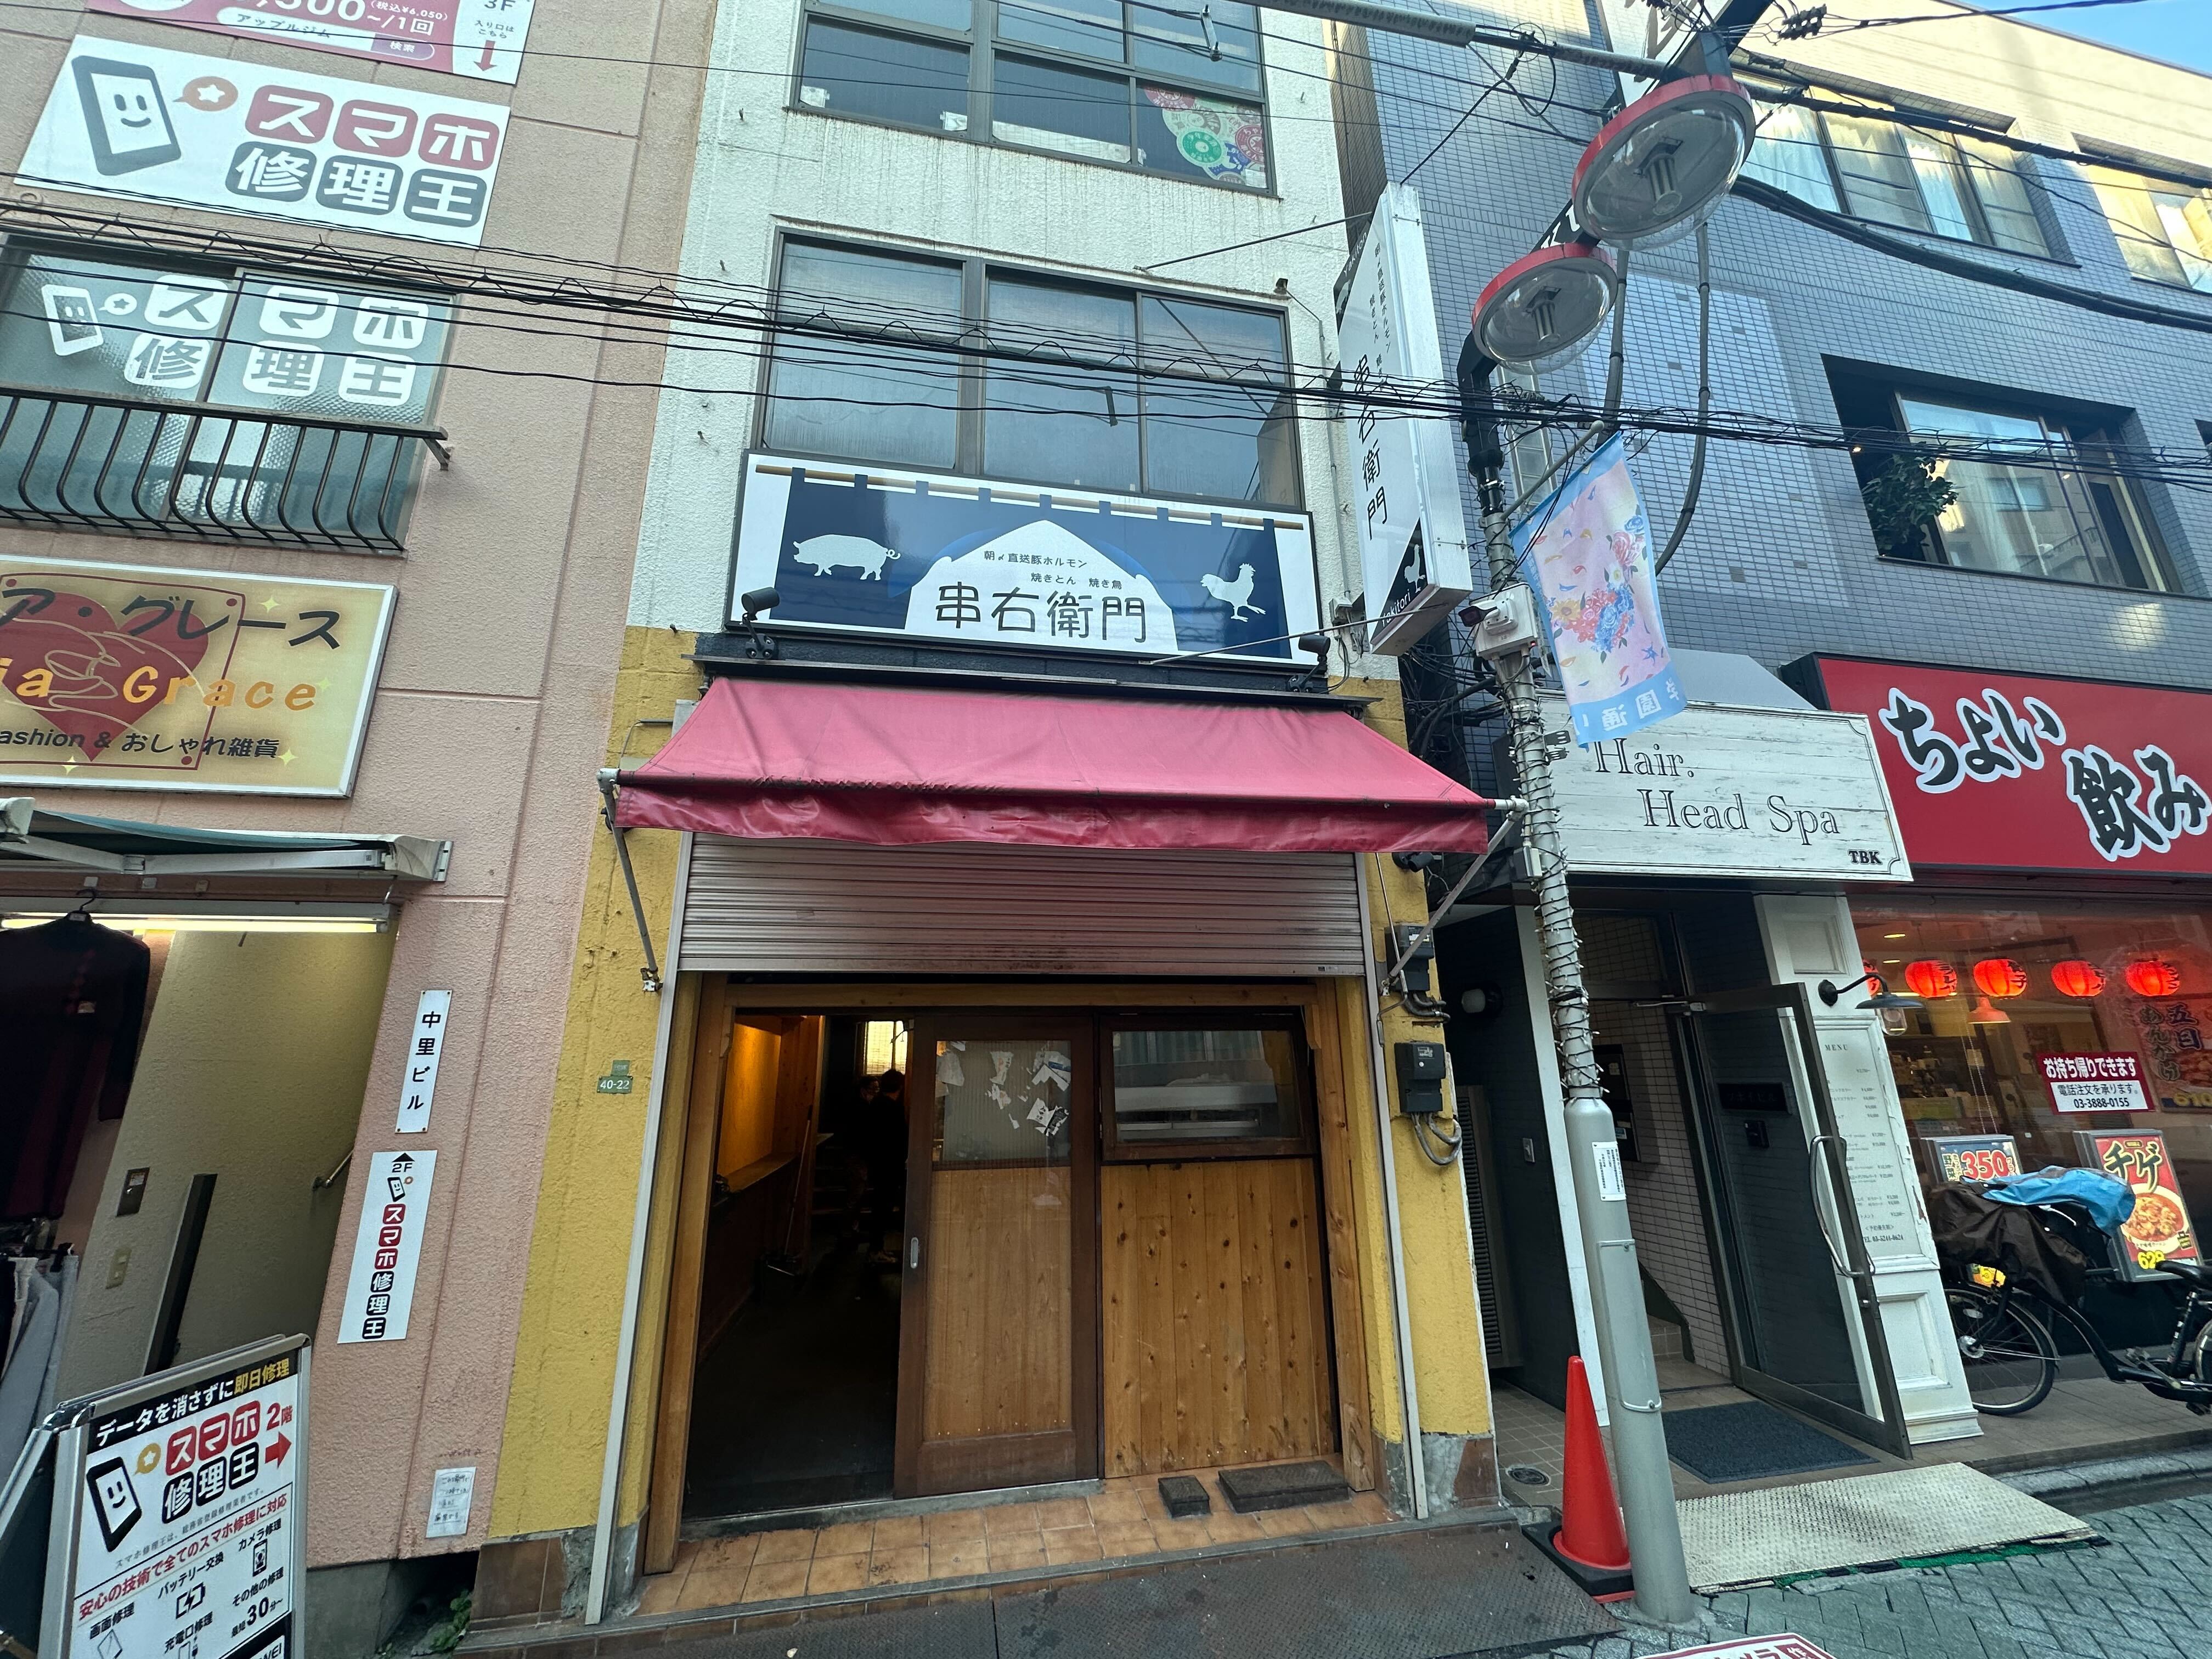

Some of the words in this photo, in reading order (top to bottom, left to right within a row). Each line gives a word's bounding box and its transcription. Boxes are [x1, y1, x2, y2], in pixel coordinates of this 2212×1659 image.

[390, 41, 415, 53] 検索
[475, 20, 514, 33] 入り口は
[478, 29, 507, 39] こちら
[258, 92, 495, 163] スマホ
[235, 148, 480, 221] 修理王
[1344, 232, 1367, 277] Yakiton
[157, 278, 419, 341] スマホ
[134, 337, 413, 399] 修理王
[1030, 572, 1076, 585] 焼きとん
[1088, 577, 1122, 590] 焼き鳥
[0, 588, 341, 650] ア・グレース
[935, 581, 1147, 644] 串右衛門
[122, 665, 317, 711] Grace
[94, 732, 111, 748] &
[121, 732, 280, 758] おしゃれ雑貨
[1594, 737, 1695, 778] Hair.
[1882, 692, 2063, 789] ちょい
[1637, 789, 1749, 830] Head
[1768, 795, 1841, 846] Spa
[2064, 747, 2209, 857] 飲み
[1848, 849, 1882, 865] TBK
[2168, 1002, 2203, 1051] 五目
[406, 1011, 442, 1111] 中里ビル
[2043, 1057, 2137, 1079] お持ち帰りできます
[600, 1080, 630, 1090] 40-22
[2058, 1083, 2138, 1096] 電話注文を承ります。
[2074, 1097, 2130, 1108] 03-3888-0155
[392, 1163, 413, 1173] 2F
[1962, 1150, 2010, 1180] 350
[2104, 1142, 2160, 1191] チゲ
[364, 1206, 403, 1338] スマホ修理王
[96, 1358, 290, 1447] データを消さずに即日修理
[169, 1403, 259, 1471] スマホ
[266, 1402, 293, 1431] 2階
[164, 1445, 258, 1522] 修理王
[79, 1493, 287, 1621] 安心の技術で全てのスマホ修理に対応
[239, 1518, 282, 1552] カメラ修理
[157, 1551, 224, 1599] バッテリー交換
[232, 1566, 284, 1607] その他の修理
[89, 1601, 135, 1639] 画面修理
[164, 1611, 213, 1655] 充電口修理
